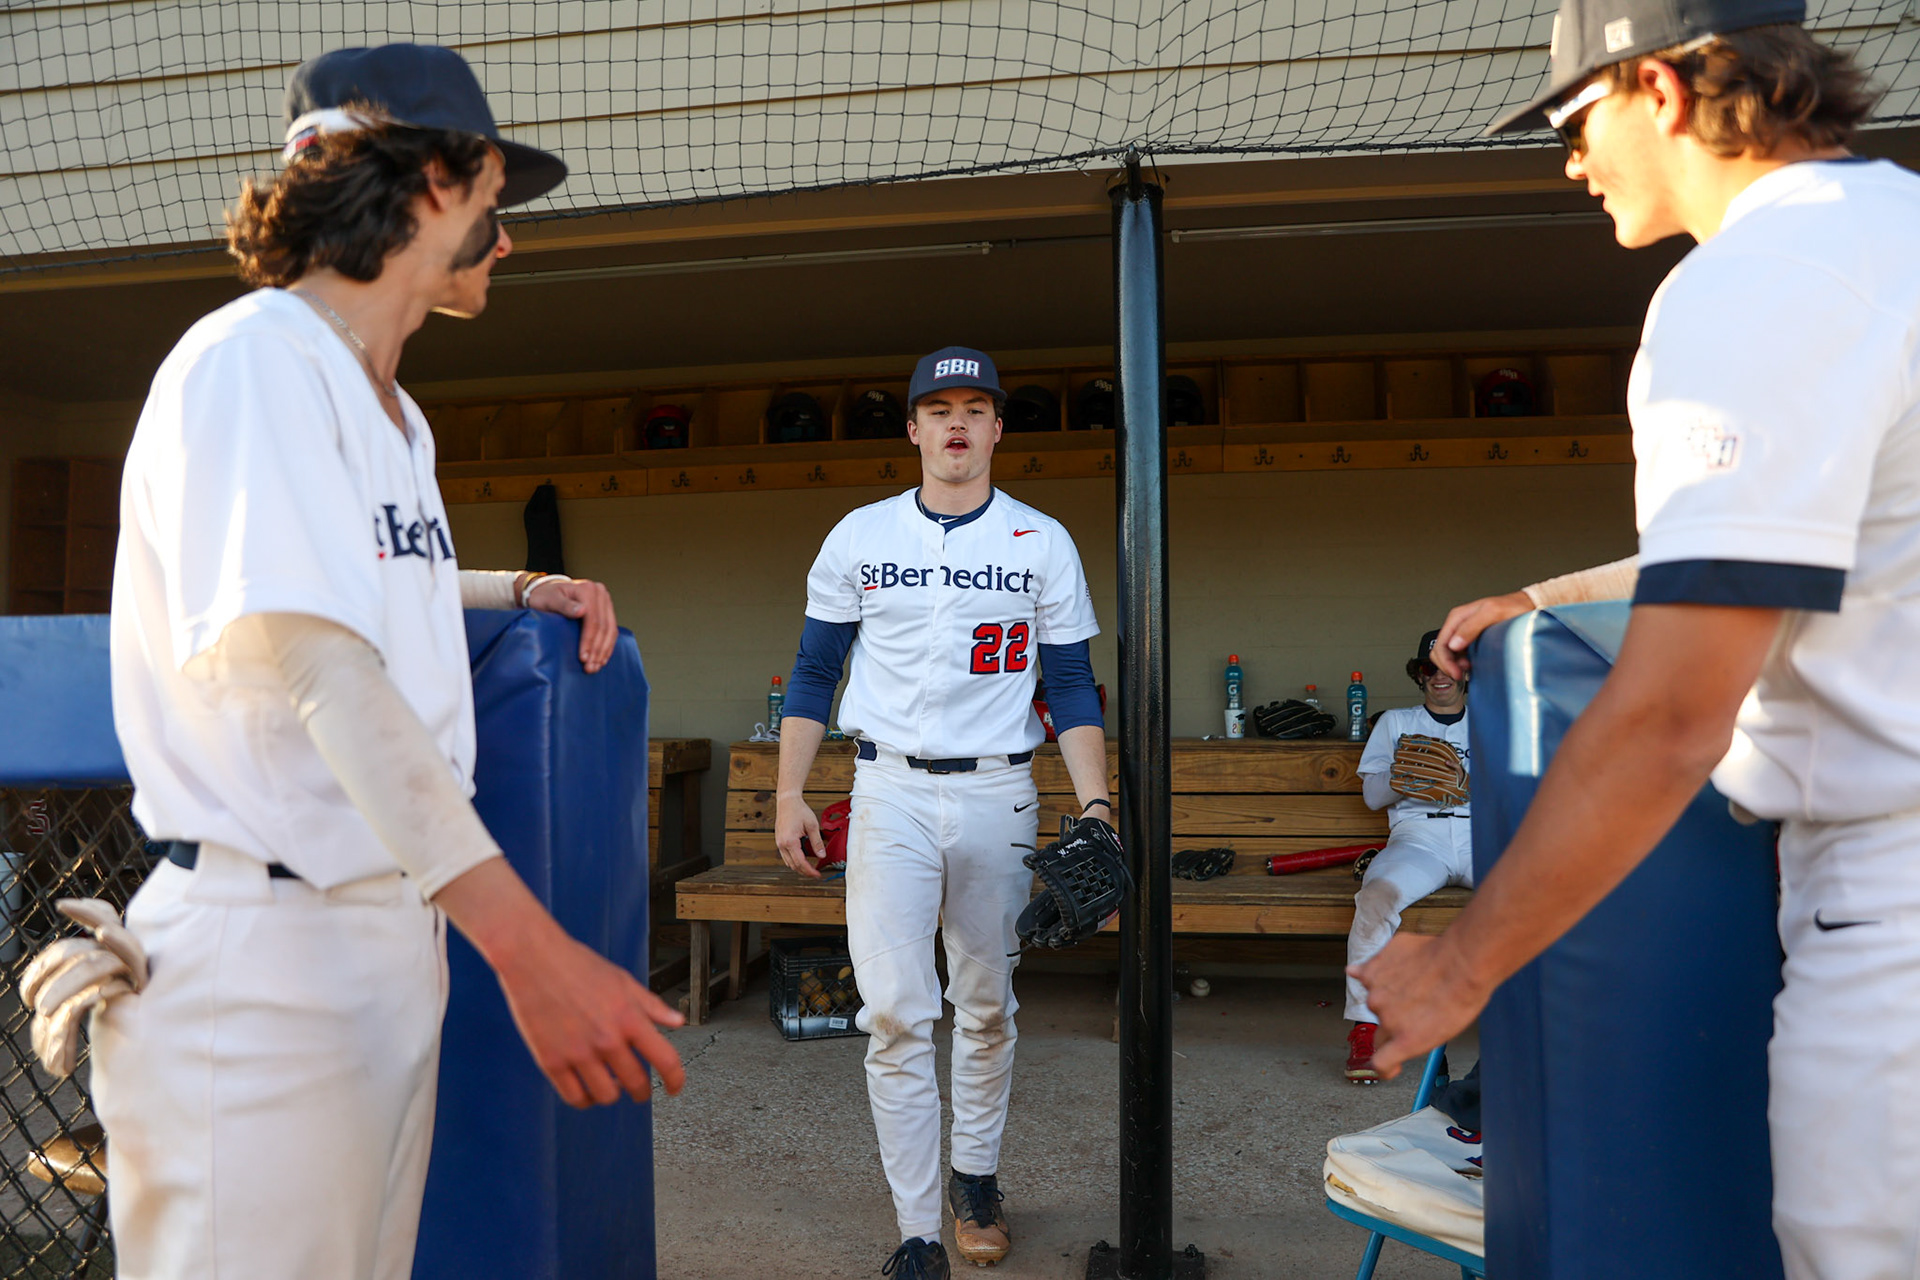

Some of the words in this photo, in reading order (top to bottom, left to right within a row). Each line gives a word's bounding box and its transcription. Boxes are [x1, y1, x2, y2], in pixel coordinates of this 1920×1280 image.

[934, 357, 981, 380] SBA
[969, 621, 1030, 675] 22
[1228, 684, 1238, 695] G
[1351, 704, 1362, 716] G
